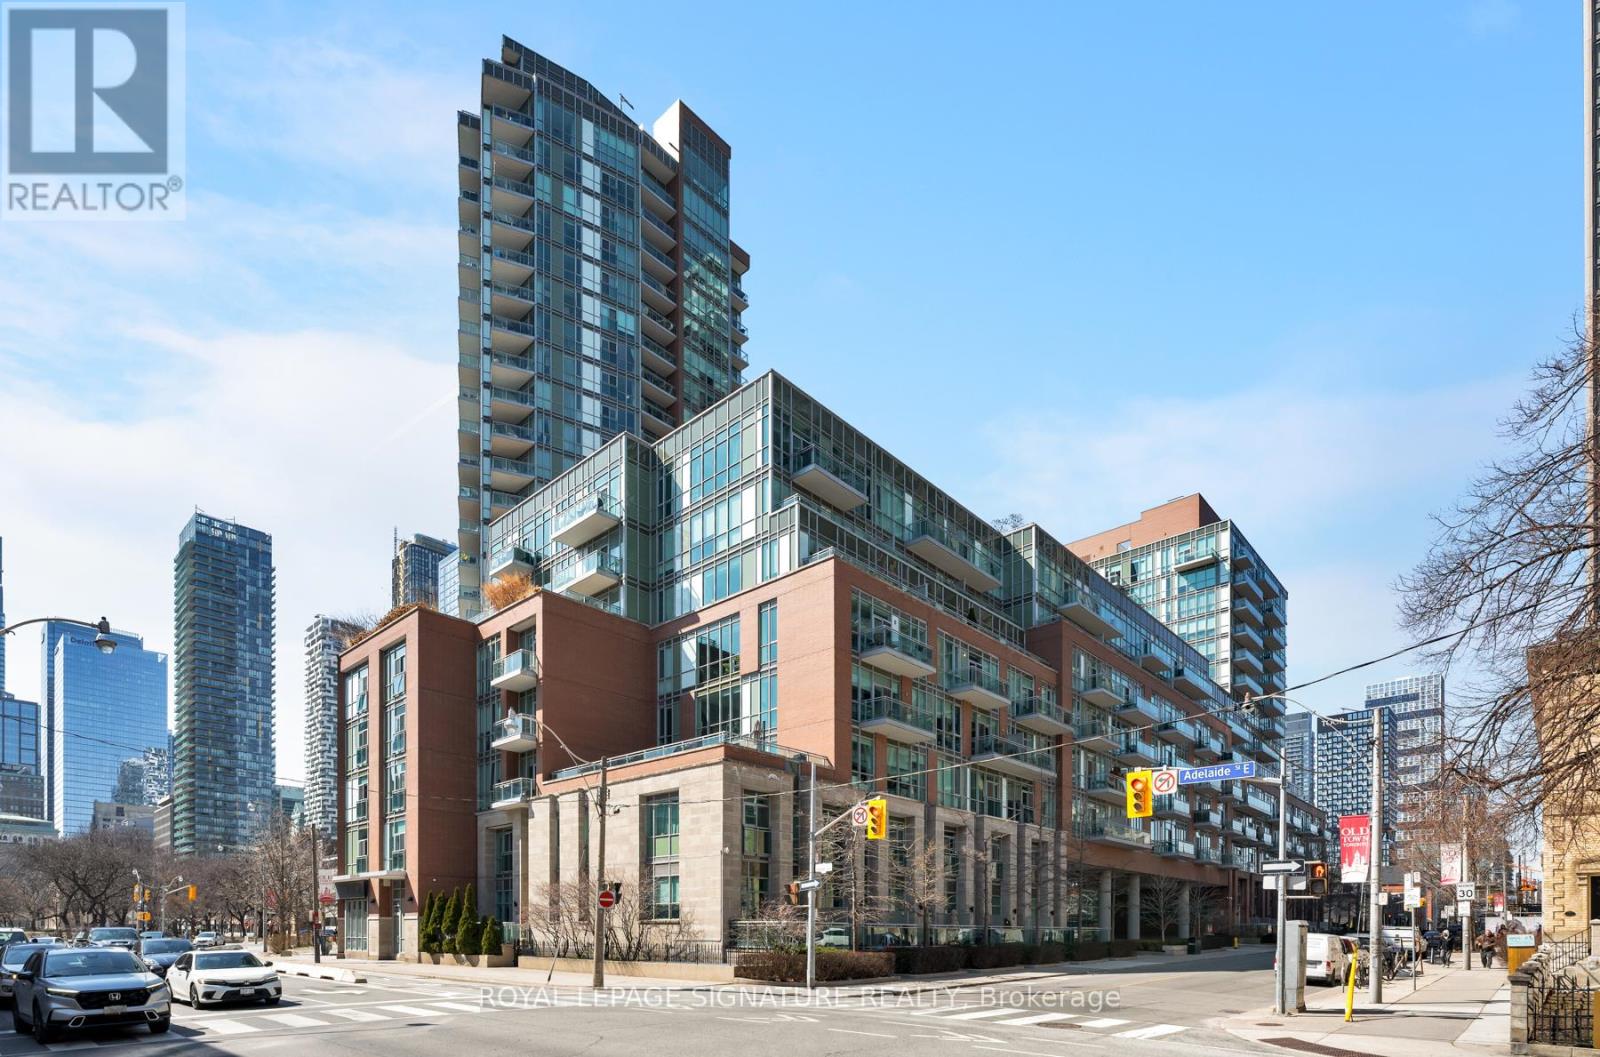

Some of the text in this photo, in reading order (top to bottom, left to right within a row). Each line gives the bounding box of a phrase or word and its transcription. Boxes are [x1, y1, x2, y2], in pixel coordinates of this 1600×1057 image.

[1184, 767, 1231, 780] Adelaide
[1243, 763, 1250, 774] E
[1341, 827, 1369, 836] OLD
